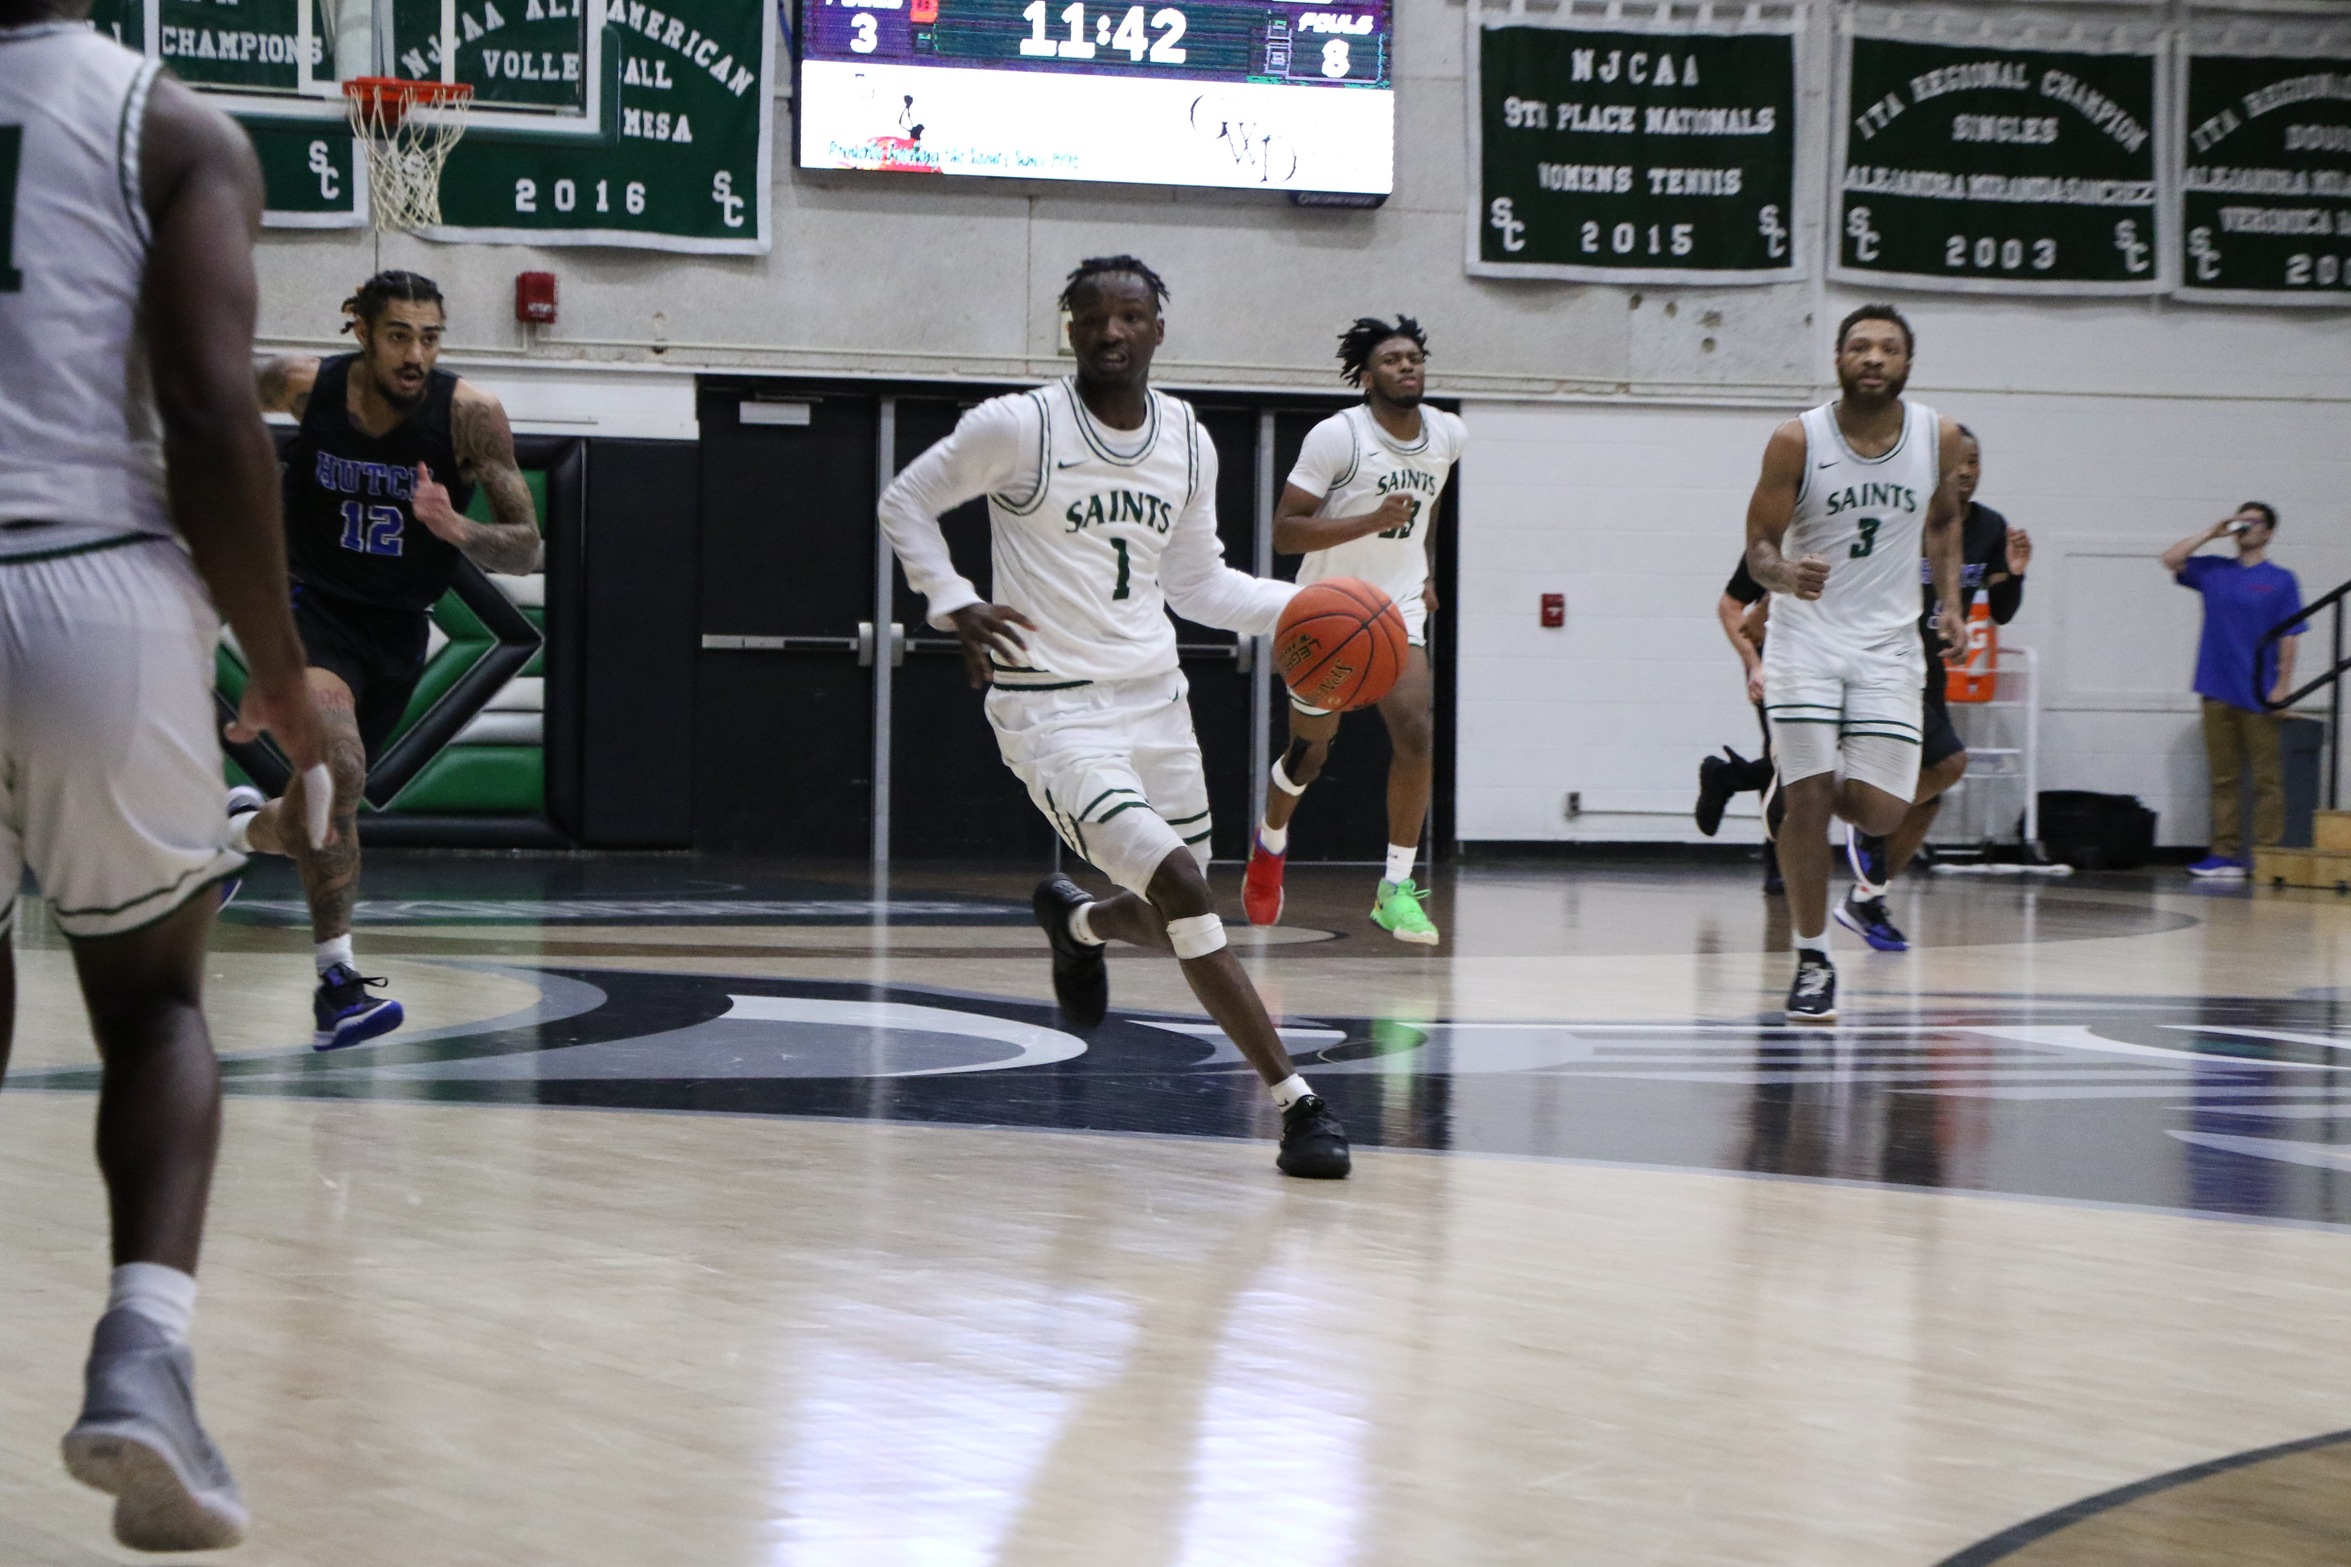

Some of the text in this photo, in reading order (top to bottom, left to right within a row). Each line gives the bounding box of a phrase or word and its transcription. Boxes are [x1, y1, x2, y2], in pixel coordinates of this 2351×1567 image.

[401, 1, 505, 79] NJAA
[606, 0, 754, 97] AMERICAN
[850, 12, 878, 53] 3
[1020, 0, 1187, 63] 11:42
[1321, 39, 1351, 78] 8
[1570, 49, 1700, 86] NJCAA
[623, 108, 692, 143] MESA
[1556, 103, 1636, 133] PLACE
[1855, 92, 1906, 141] ITA
[515, 178, 646, 214] 2016
[1647, 167, 1742, 196] TENNIS
[1581, 221, 1693, 256] 2015
[1946, 235, 2057, 270] 2003
[1375, 468, 1436, 496] SAINTS
[1827, 482, 1917, 516] SAINTS
[340, 501, 404, 557] 12
[1065, 490, 1172, 534] SAINTS
[1850, 518, 1882, 559] 3
[1109, 537, 1131, 601] 1
